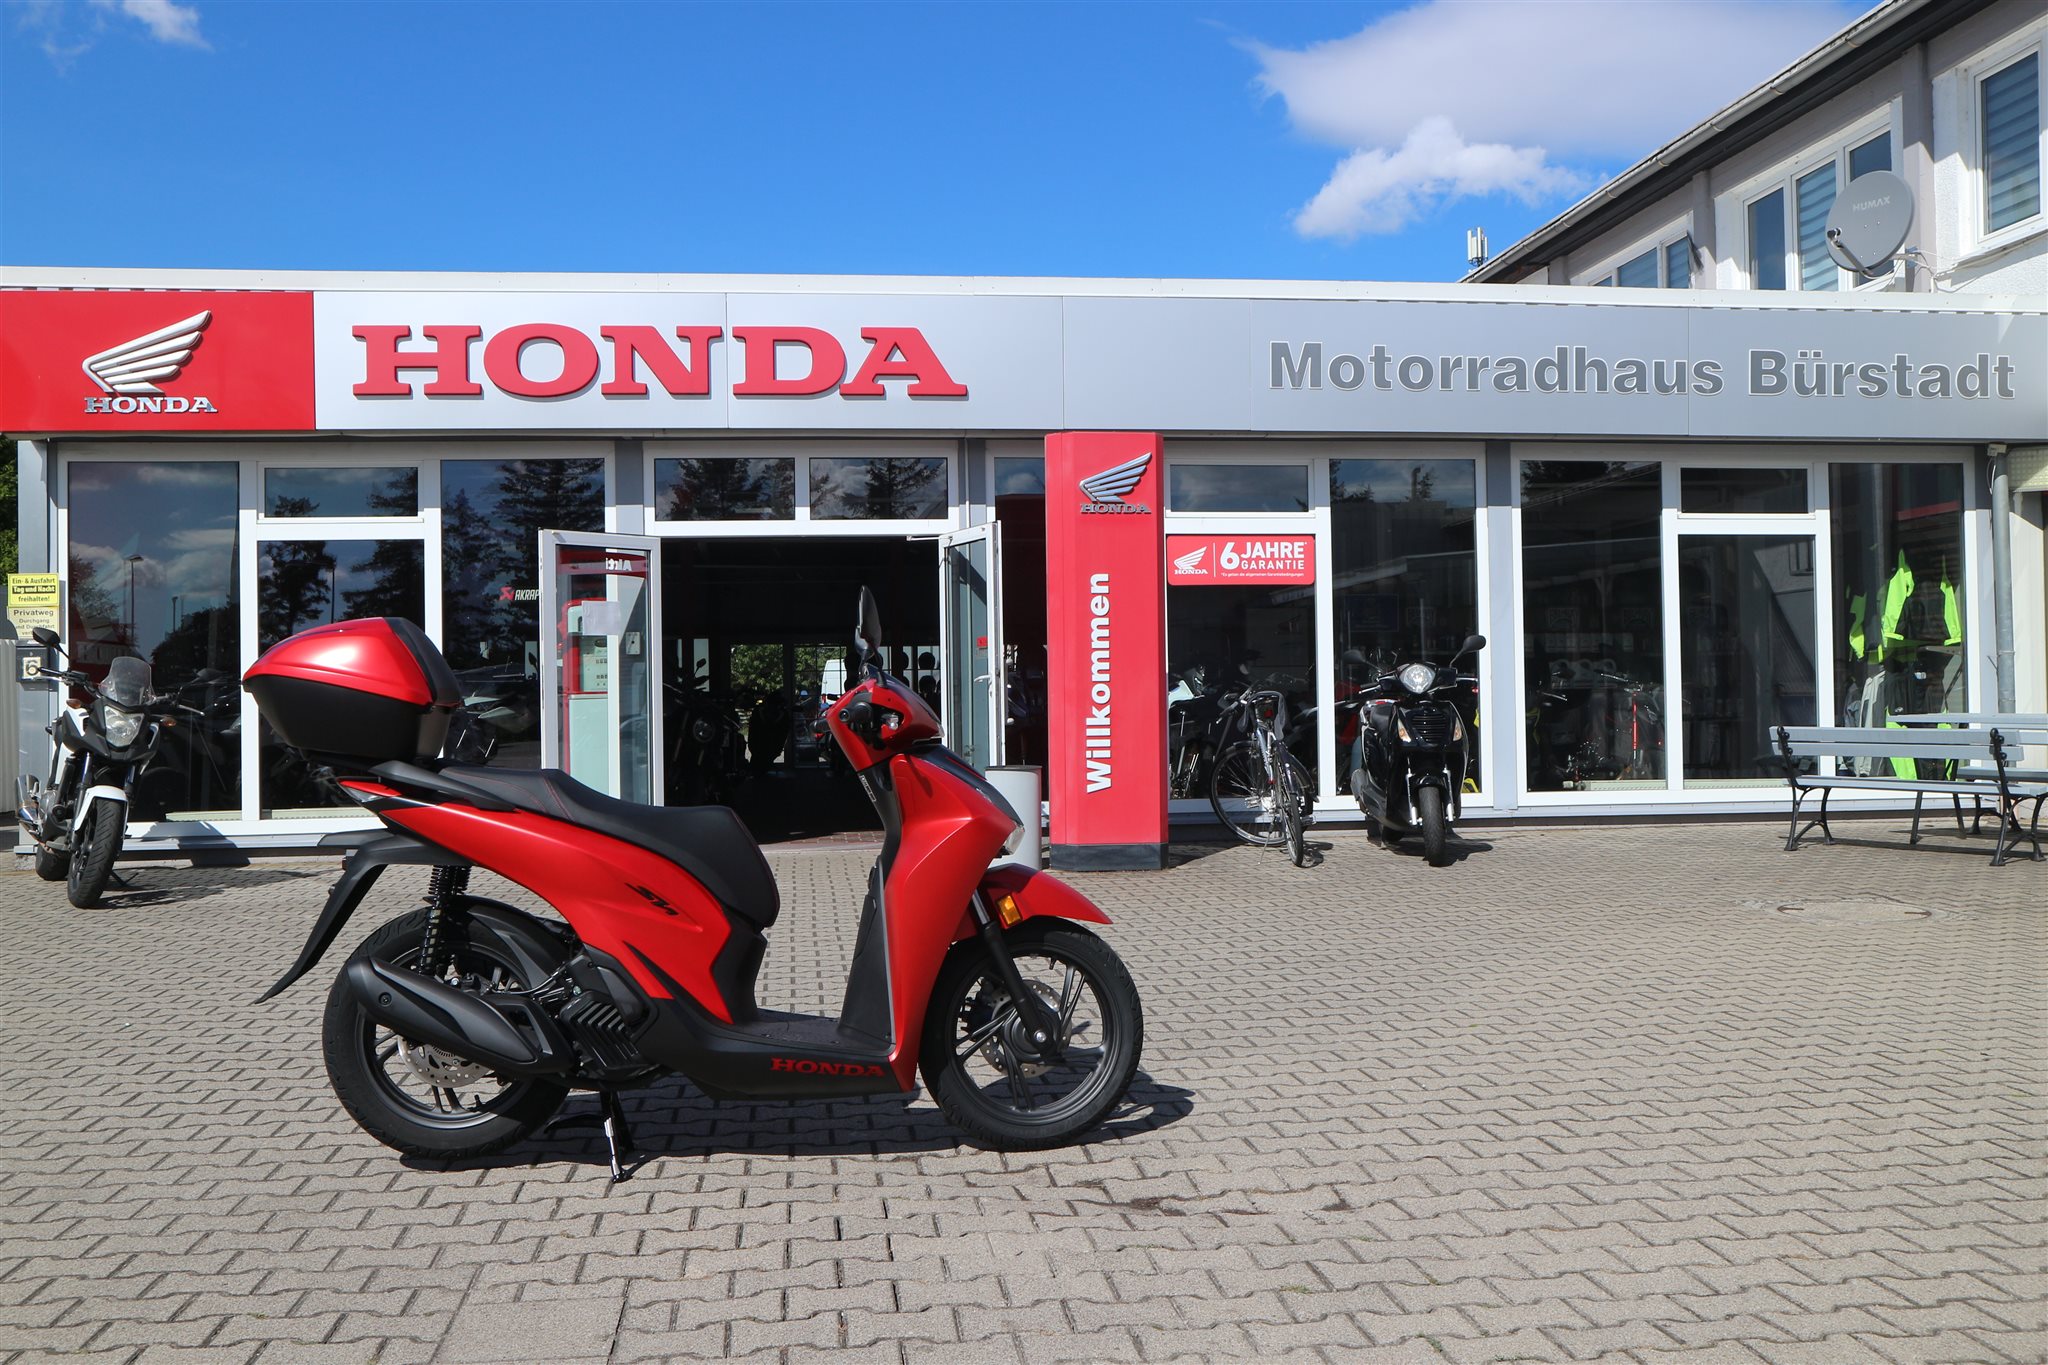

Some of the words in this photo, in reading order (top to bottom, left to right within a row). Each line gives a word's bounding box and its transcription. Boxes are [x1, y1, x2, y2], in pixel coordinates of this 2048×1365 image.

[1852, 196, 1890, 211] HUMAX
[351, 323, 969, 399] HONDA
[1268, 340, 1726, 397] Motorradhaus
[1748, 348, 2016, 400] Bürstadt
[84, 396, 218, 414] HONDA
[1080, 503, 1152, 515] HONDA
[1220, 542, 1240, 570] 6
[1241, 560, 1305, 570] GARANTIE
[13, 586, 25, 594] Tag
[38, 585, 56, 593] Nacht
[514, 590, 540, 601] AKRAP
[13, 609, 54, 617] Privatweg
[25, 659, 40, 676] 6
[1085, 573, 1112, 795] Willkommen
[770, 1057, 886, 1078] HONDA
